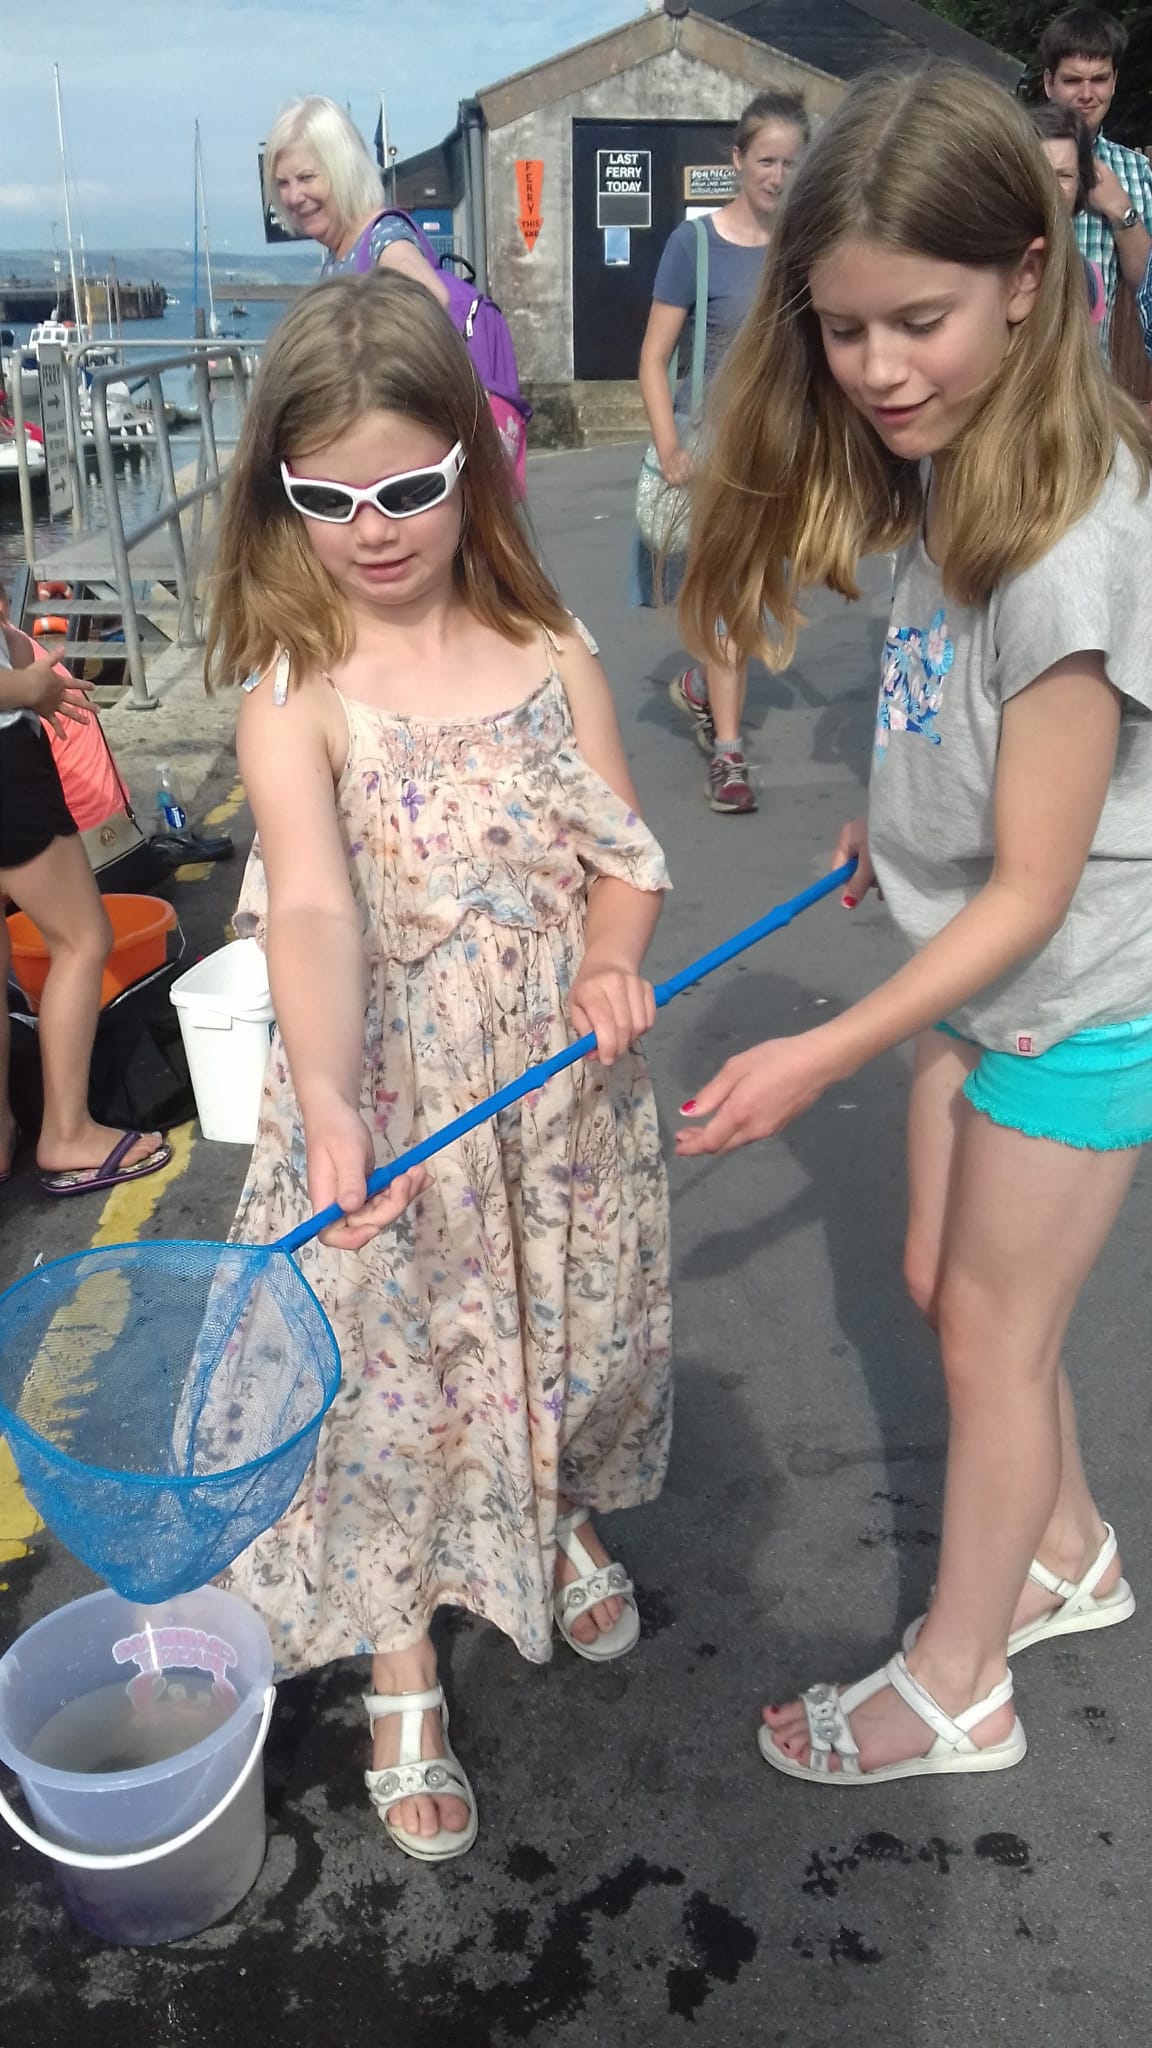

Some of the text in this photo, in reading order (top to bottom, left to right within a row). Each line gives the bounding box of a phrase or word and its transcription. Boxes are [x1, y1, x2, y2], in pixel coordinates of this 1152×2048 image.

[610, 153, 639, 165] LAST
[606, 167, 642, 178] FERRY
[525, 161, 534, 215] FERRY
[606, 181, 642, 192] TODAY
